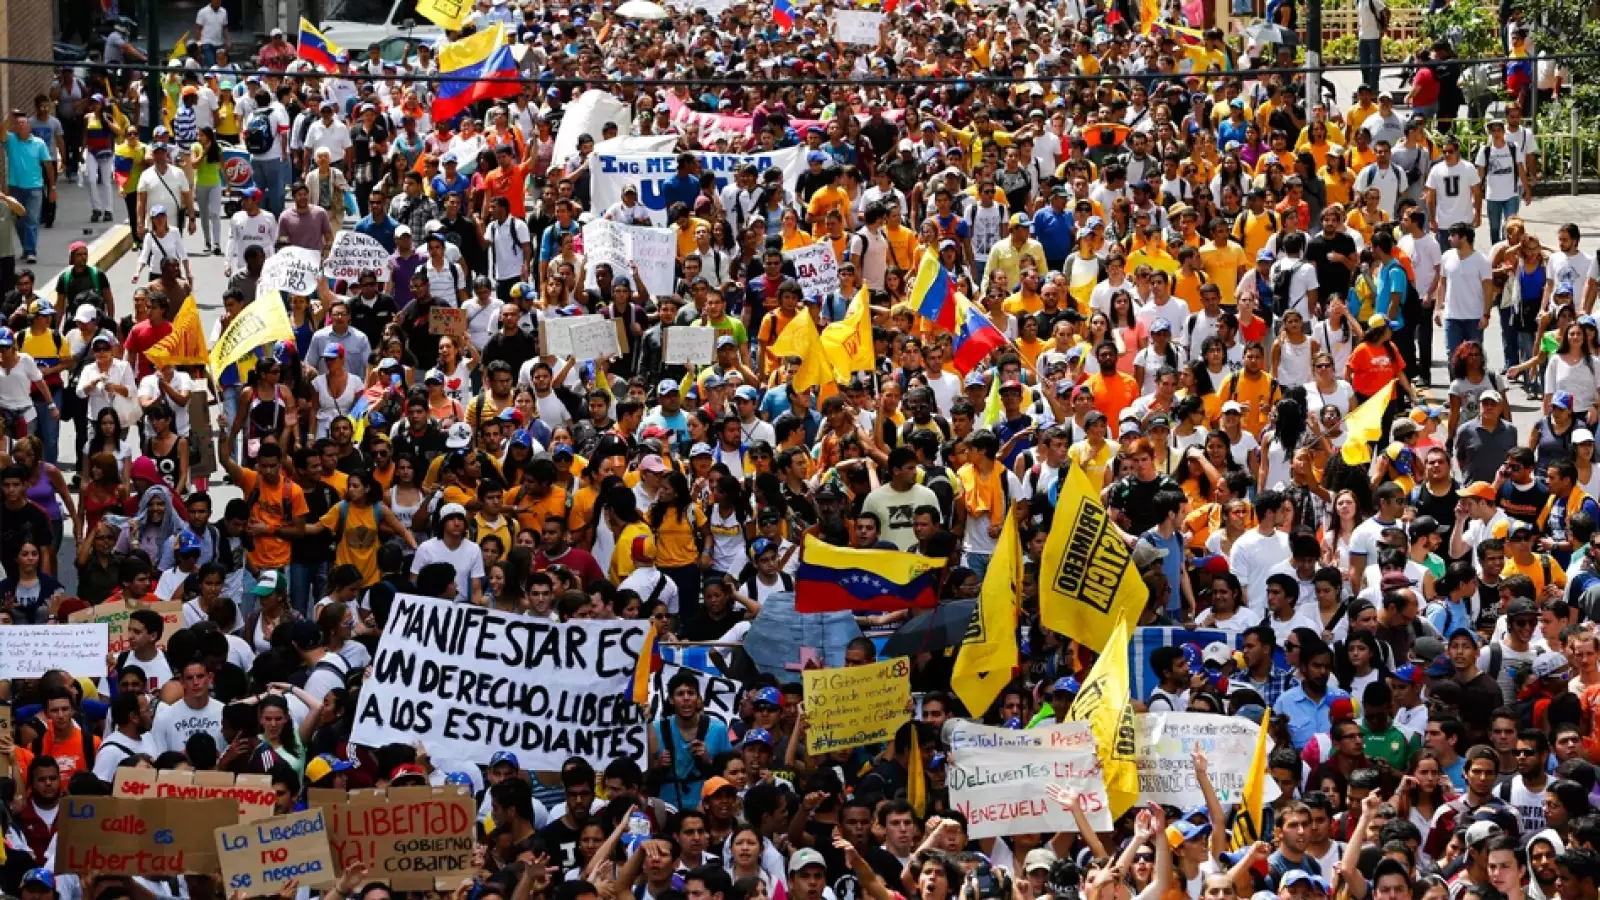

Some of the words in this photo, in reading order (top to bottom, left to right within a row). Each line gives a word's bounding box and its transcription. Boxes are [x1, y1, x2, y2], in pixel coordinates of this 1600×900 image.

[1444, 176, 1460, 196] U
[390, 599, 587, 670] MANIFESTAR
[596, 627, 643, 677] ES
[375, 649, 415, 686] UN
[808, 694, 827, 706] NO
[359, 694, 383, 726] A
[390, 696, 433, 733] LOS
[444, 708, 646, 760] ESTUDIANTES
[121, 781, 150, 796] ser
[69, 801, 95, 818] La
[101, 814, 148, 835] calle
[153, 829, 175, 844] es
[222, 832, 249, 851] La
[260, 847, 288, 864] no
[230, 872, 252, 889] se
[262, 859, 323, 882] negocia
